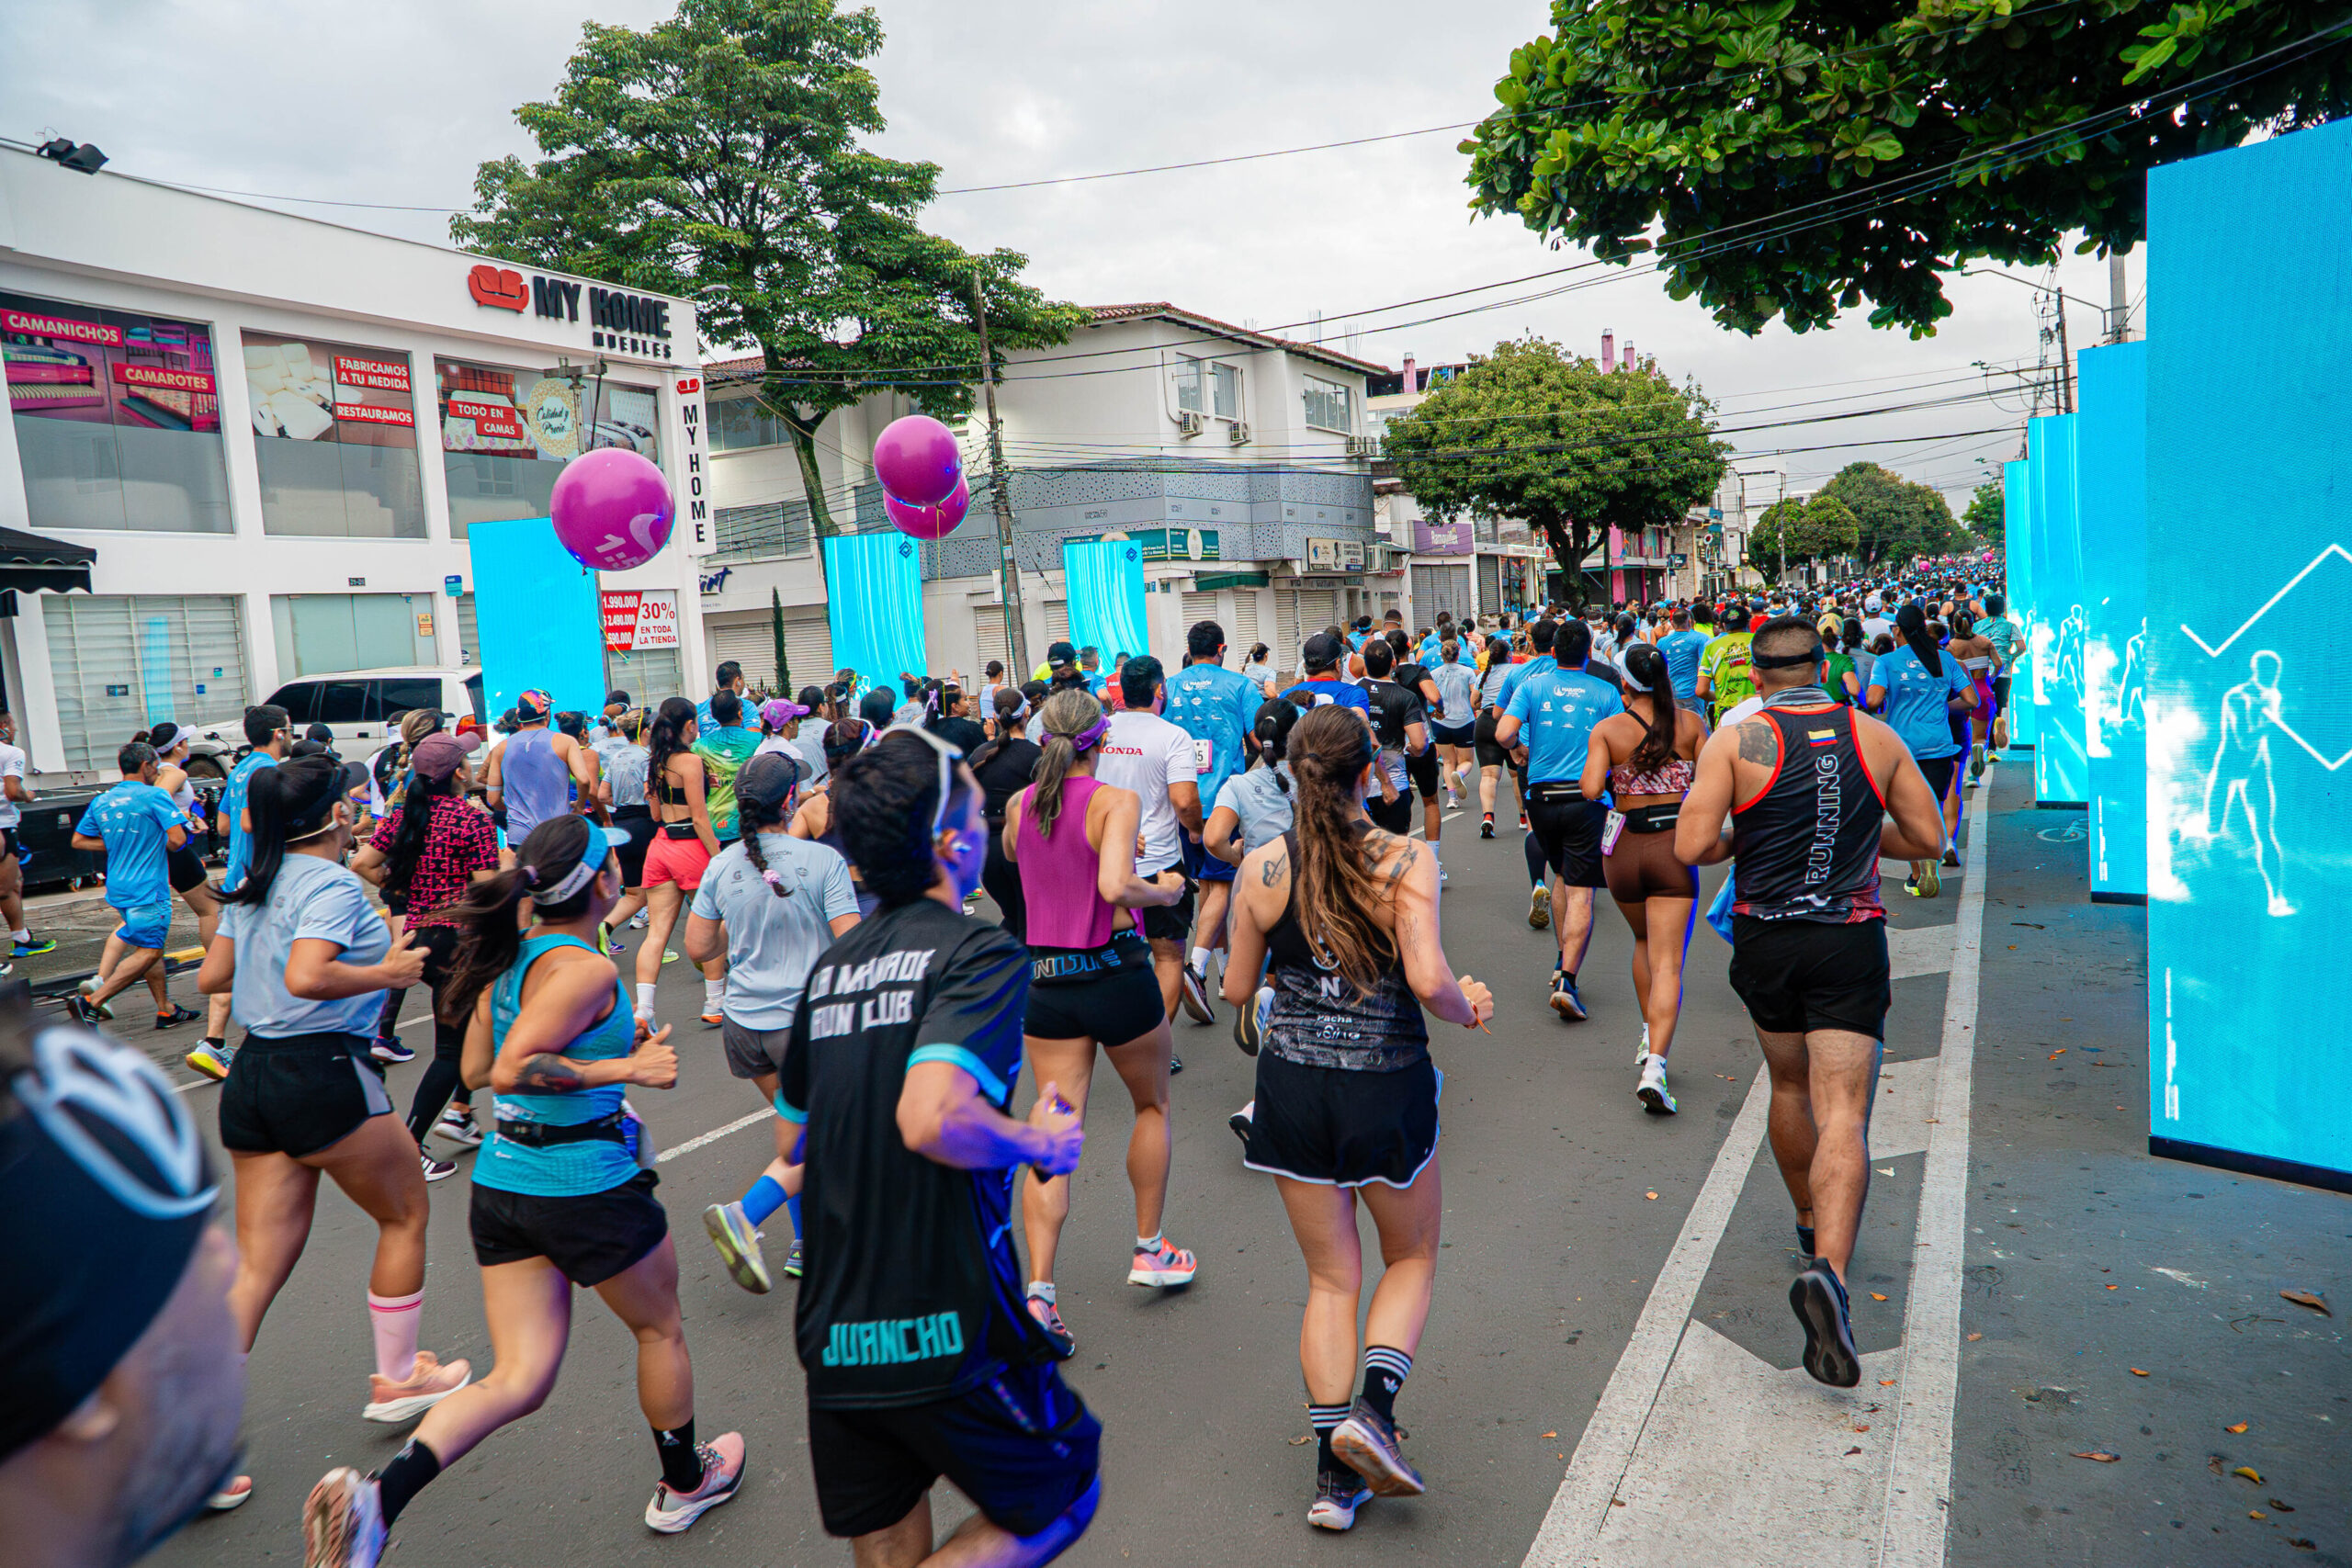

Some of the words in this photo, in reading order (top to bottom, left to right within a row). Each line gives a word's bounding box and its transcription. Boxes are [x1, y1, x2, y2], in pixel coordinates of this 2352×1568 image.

[533, 276, 582, 322] MY
[589, 287, 672, 338] HOME
[8, 314, 119, 343] CAMANICHOS
[593, 331, 672, 359] MUEBLES
[340, 358, 408, 377] FABRICAMOS
[125, 368, 209, 389] CAMAROTES
[340, 372, 349, 382] A
[351, 373, 365, 384] TU
[368, 376, 410, 389] MEDIDA
[336, 405, 413, 423] RESTAURAMOS
[457, 404, 486, 416] TODO
[490, 408, 503, 418] EN
[484, 423, 515, 434] CAMAS
[683, 404, 698, 446] MY
[689, 453, 706, 543] HOME
[603, 595, 639, 608] 1.990.000
[607, 614, 636, 626] 2.490.000
[641, 603, 675, 620] 30%
[640, 626, 650, 634] EN
[652, 626, 673, 634] TODA
[639, 637, 649, 645] LA
[650, 636, 677, 644] TIENDA
[1102, 746, 1143, 756] ONDA
[1805, 754, 1840, 885] RUNNING
[822, 1311, 965, 1367] JUANCHO
